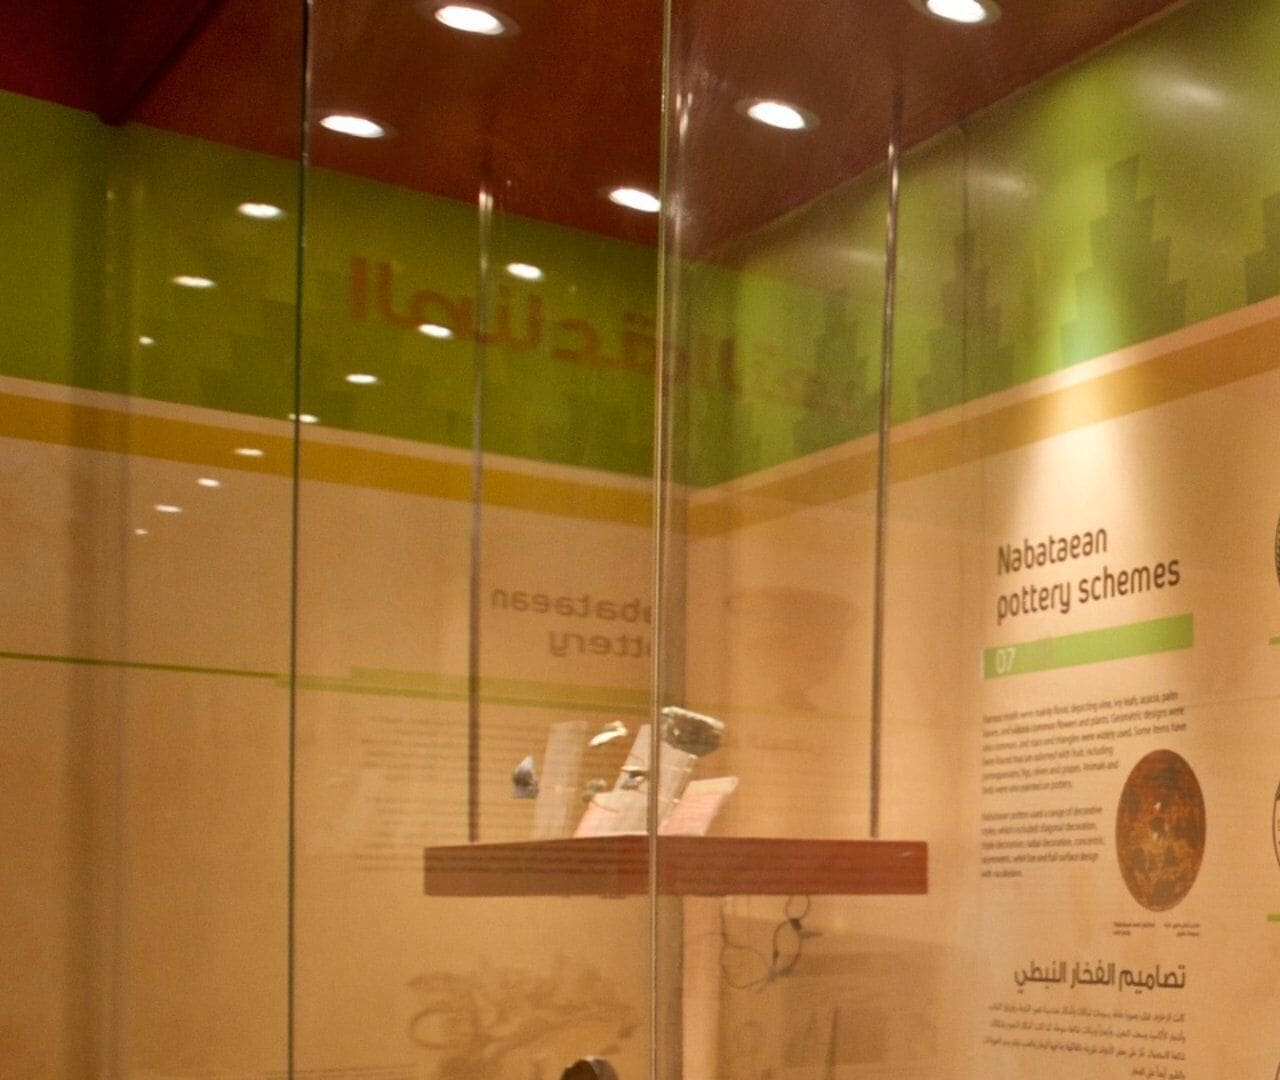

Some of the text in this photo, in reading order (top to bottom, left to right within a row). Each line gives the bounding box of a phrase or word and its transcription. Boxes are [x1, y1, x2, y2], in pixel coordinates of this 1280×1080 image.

[997, 528, 1107, 575] Nabataean
[997, 558, 1181, 626] pottery schemes
[995, 647, 1016, 674] 07
[1014, 959, 1186, 994] تصاميم الفخار النبطي
